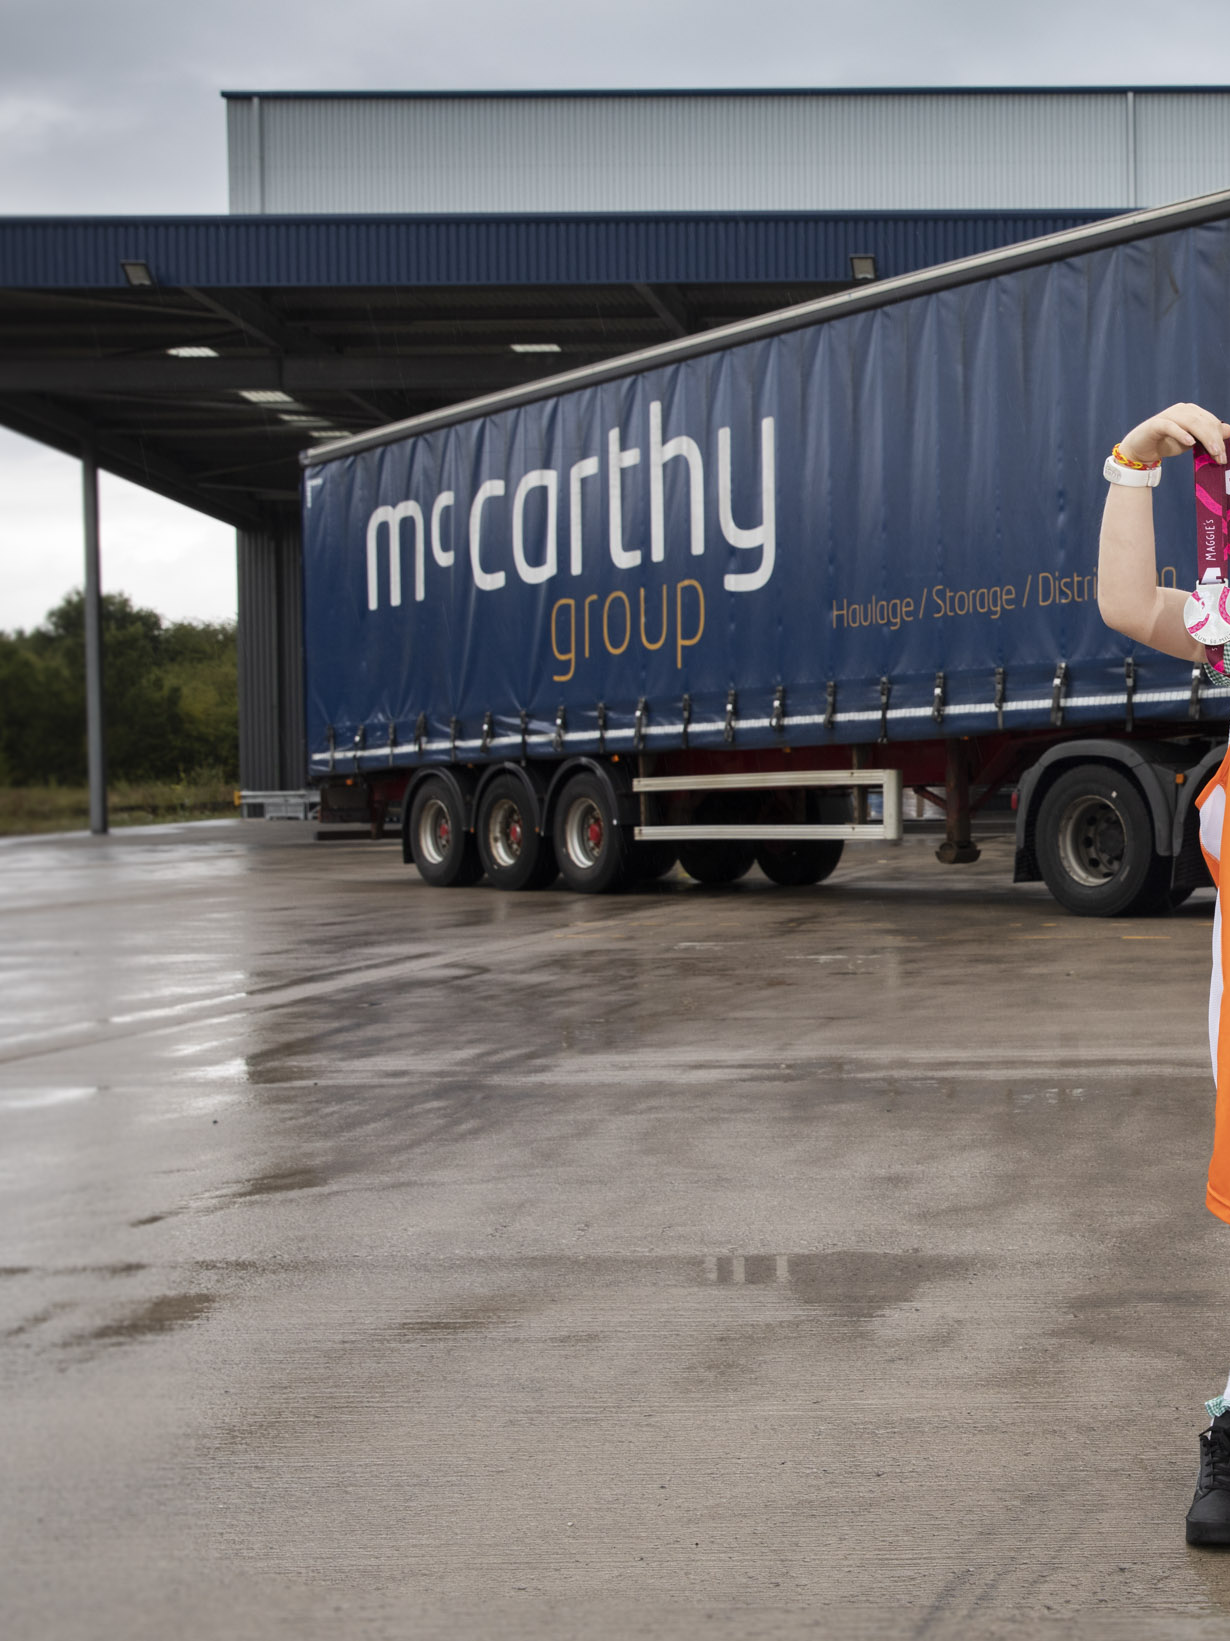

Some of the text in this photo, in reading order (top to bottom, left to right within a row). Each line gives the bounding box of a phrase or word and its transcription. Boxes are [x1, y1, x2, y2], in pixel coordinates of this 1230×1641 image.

[551, 578, 706, 682] group
[832, 598, 915, 631] Haulage
[932, 584, 1017, 620] Storage
